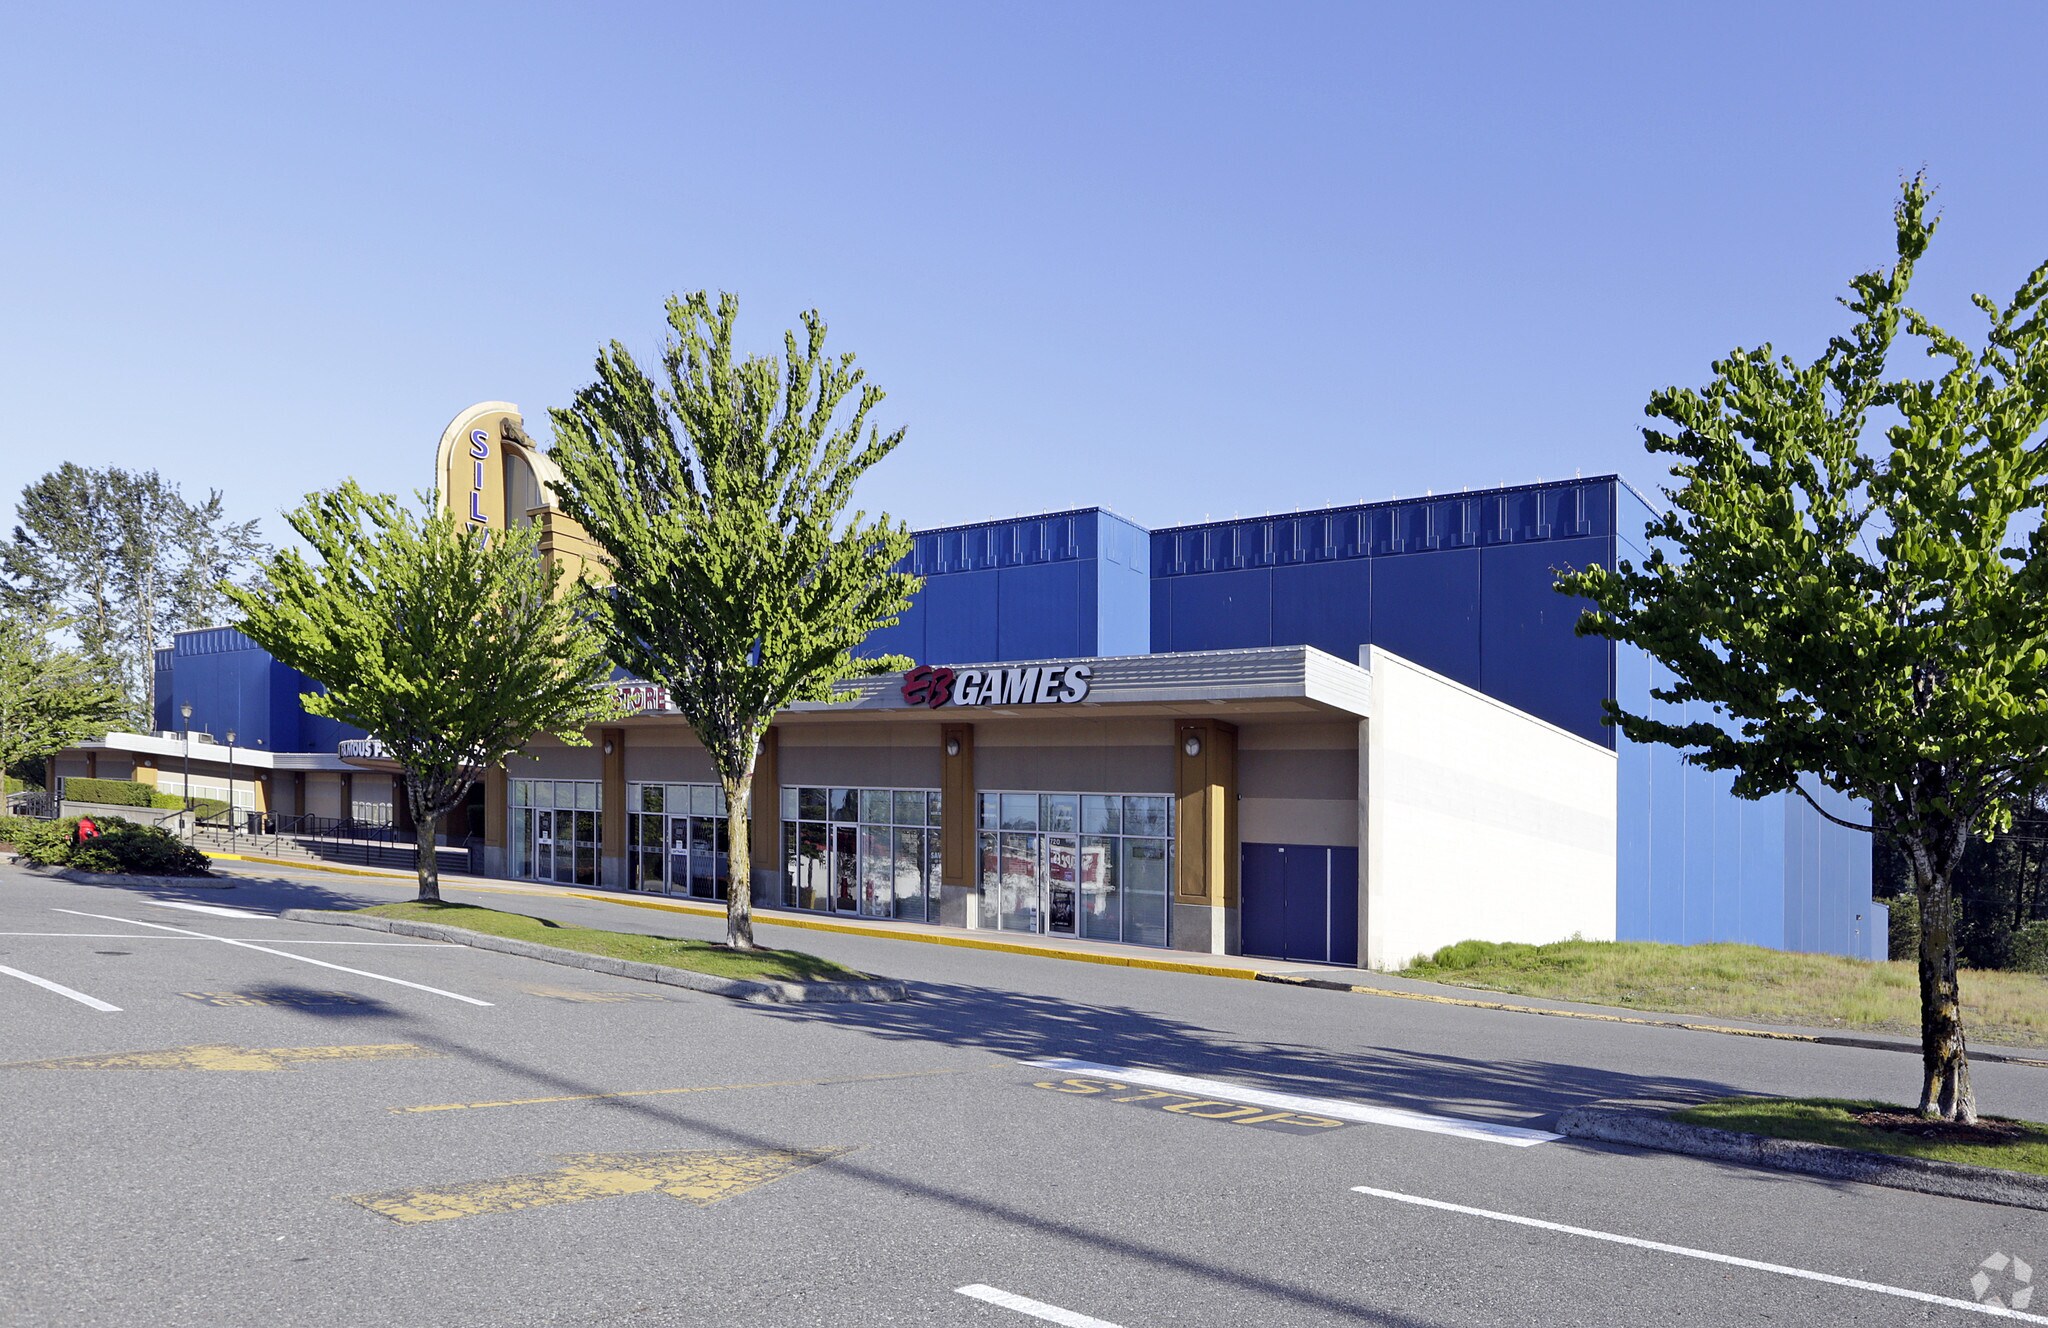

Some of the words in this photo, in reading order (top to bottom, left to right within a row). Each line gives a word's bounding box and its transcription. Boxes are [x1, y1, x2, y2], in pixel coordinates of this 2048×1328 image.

[613, 687, 669, 711] STORE
[901, 665, 955, 709] EB
[953, 664, 1092, 706] GAMES
[340, 742, 372, 758] FAMOUS
[1032, 1078, 1346, 1129] STOP
